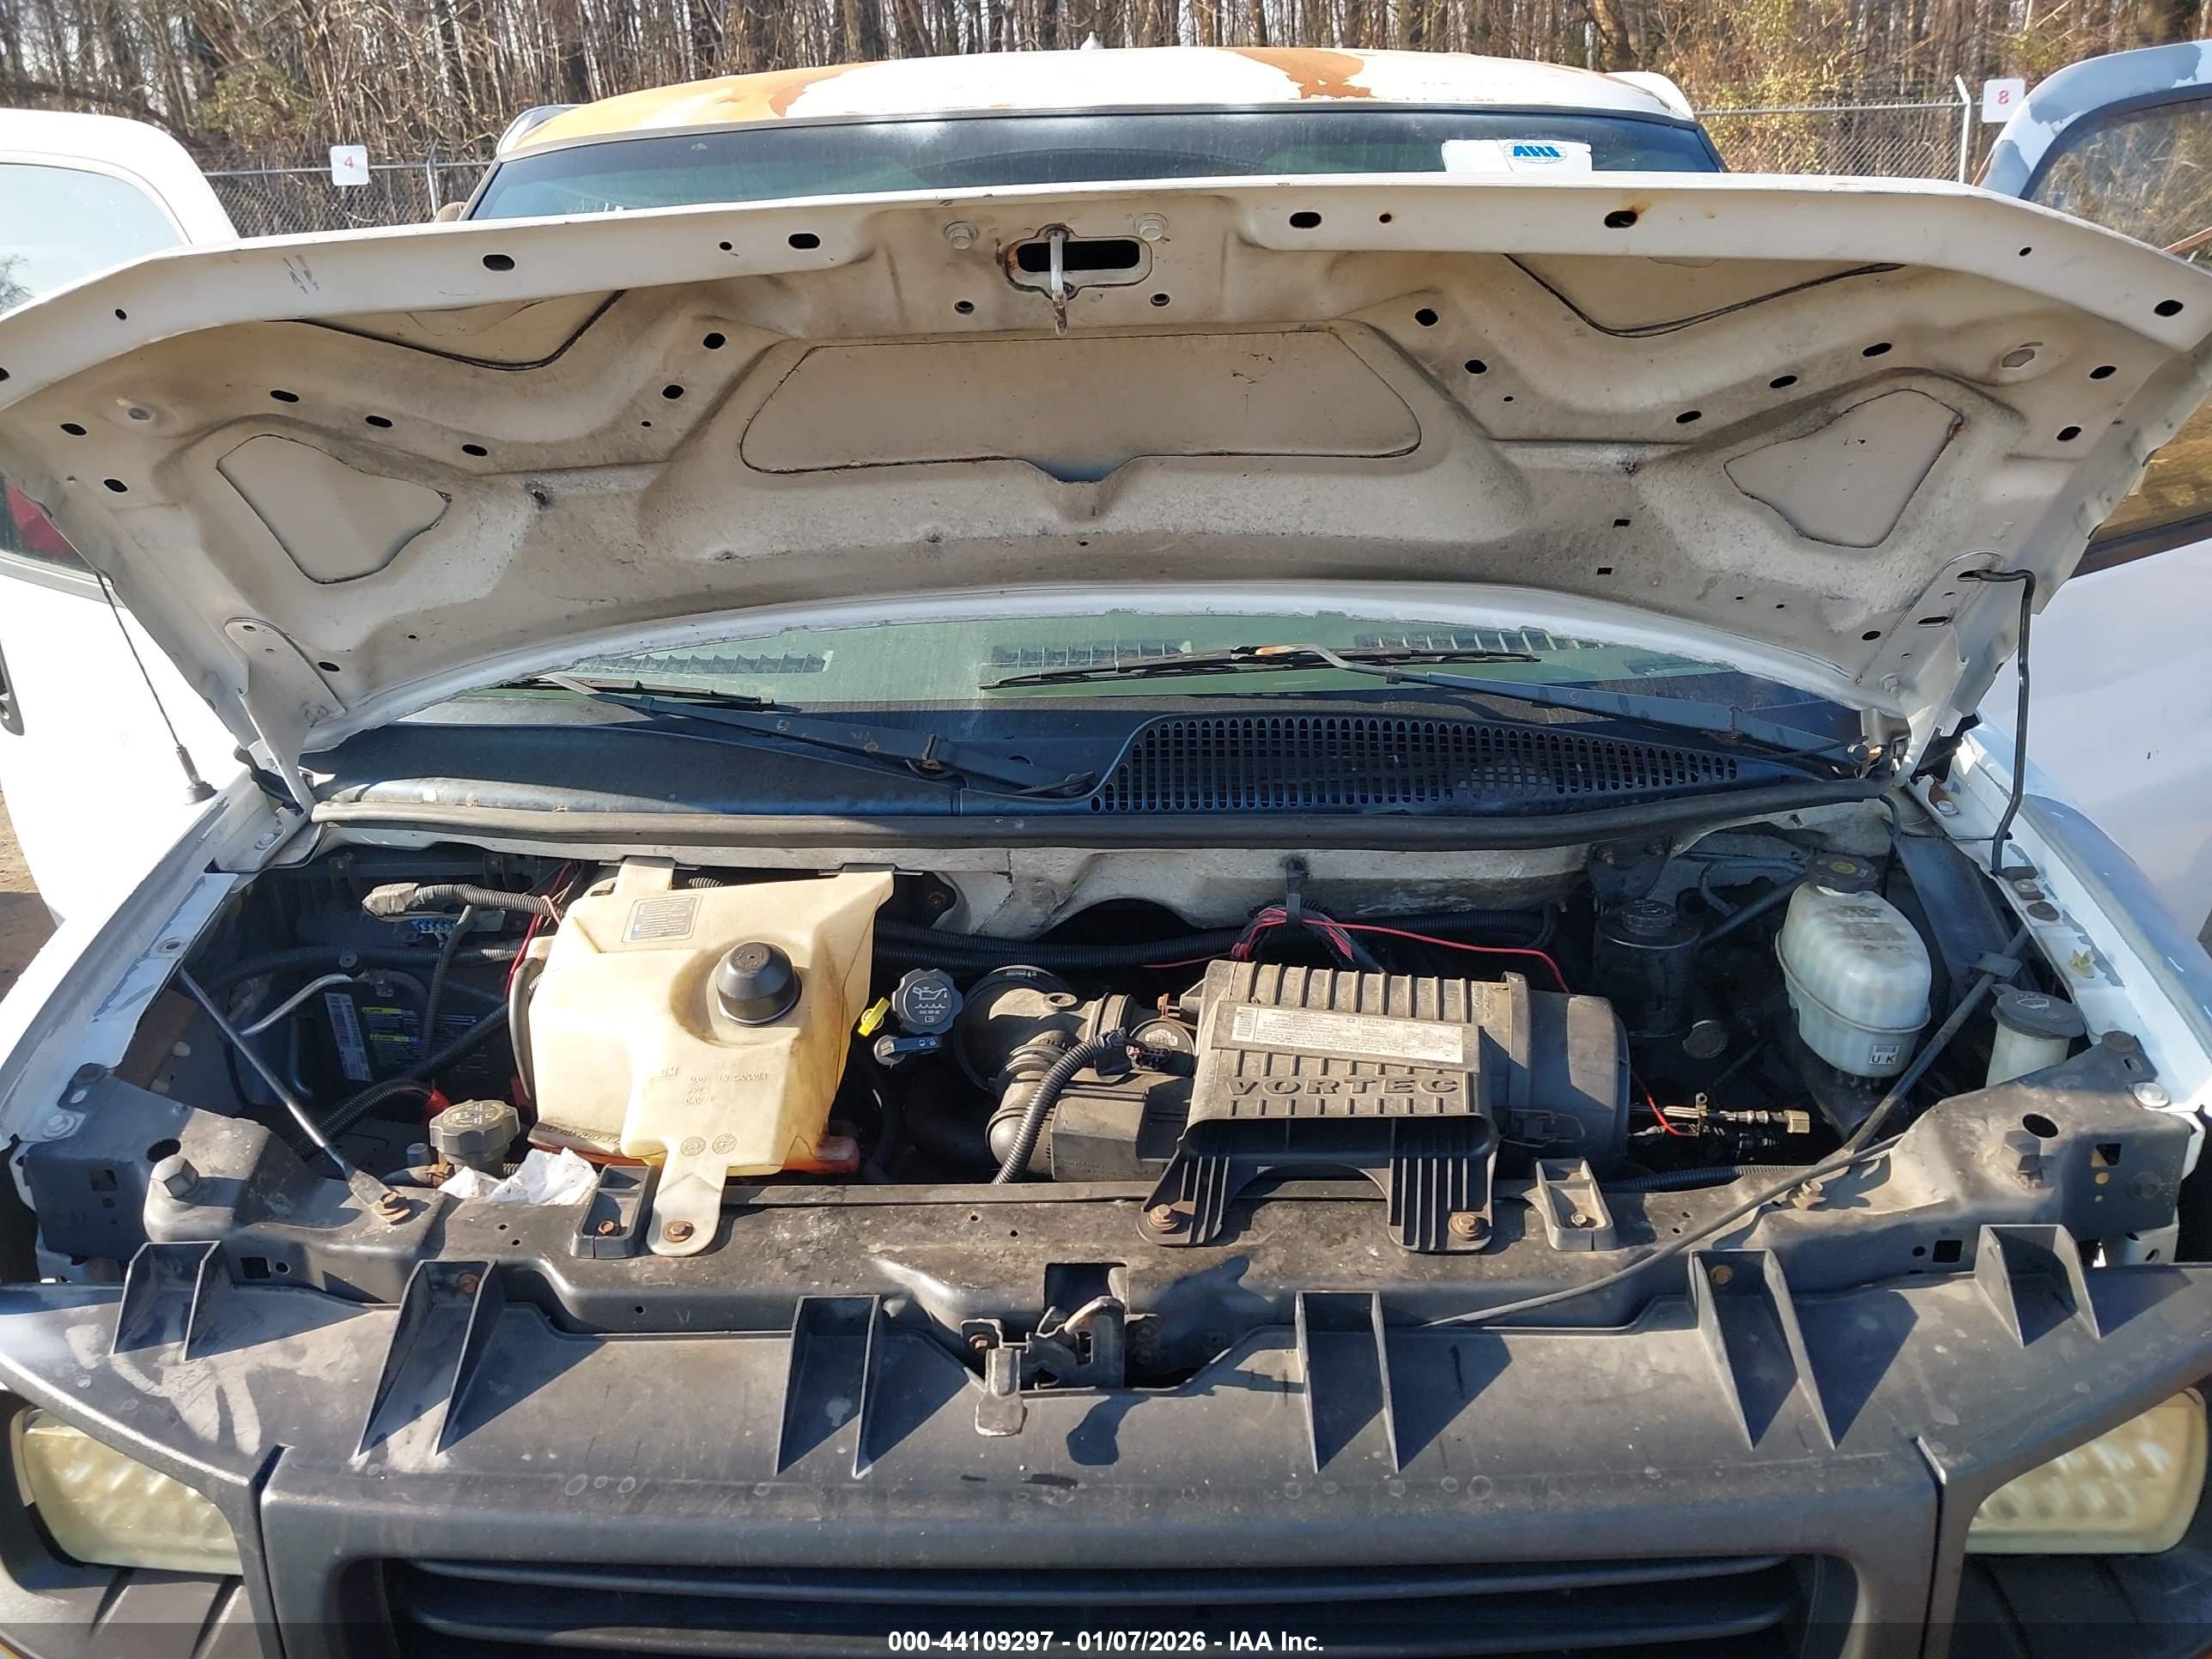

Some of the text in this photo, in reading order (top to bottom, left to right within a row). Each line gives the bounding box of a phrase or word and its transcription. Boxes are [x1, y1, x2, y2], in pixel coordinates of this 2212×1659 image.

[1998, 89, 2009, 105] 8
[344, 155, 355, 169] 4
[1871, 1054, 1896, 1063] U K
[1226, 1079, 1458, 1096] VORTEC
